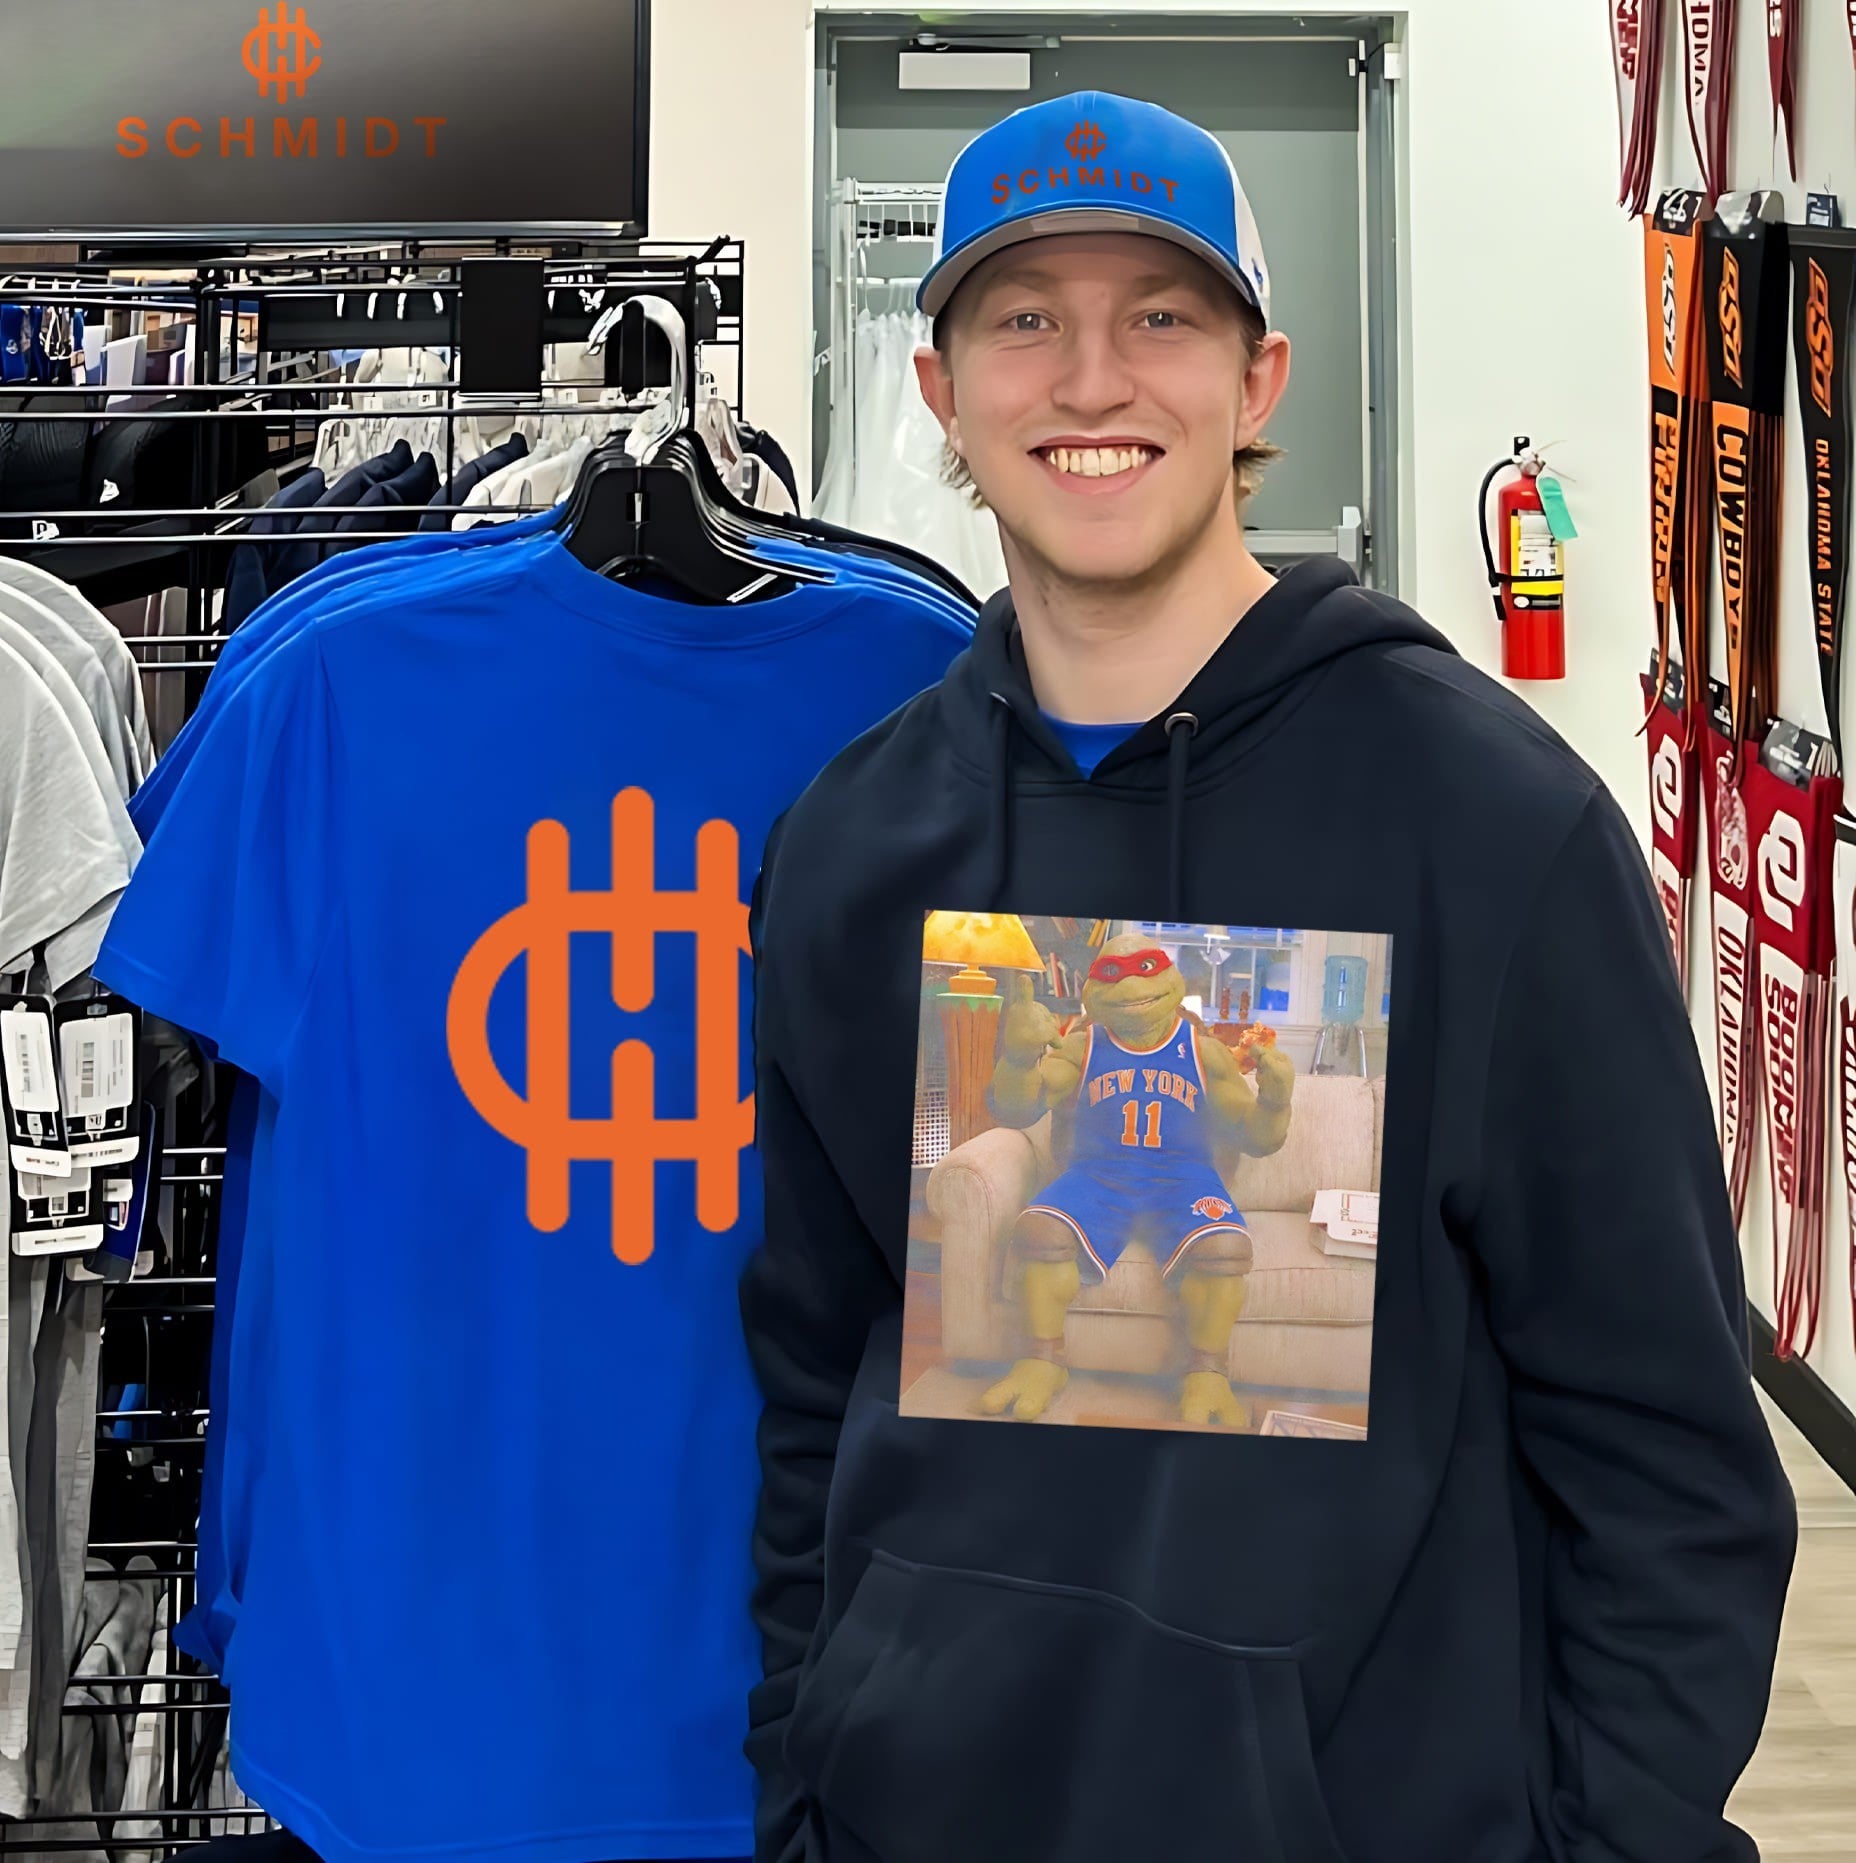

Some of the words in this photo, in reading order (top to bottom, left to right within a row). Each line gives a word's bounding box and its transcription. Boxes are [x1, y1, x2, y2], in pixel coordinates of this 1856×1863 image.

[115, 115, 449, 160] SCHMIDT
[991, 166, 1180, 205] SCHMIDT
[1815, 438, 1832, 571] OKLAHOMA
[1717, 925, 1746, 1146] OKLAHOMA
[1088, 1068, 1136, 1108] NEW
[1142, 1068, 1199, 1113] YORK
[1121, 1099, 1162, 1149] 11
